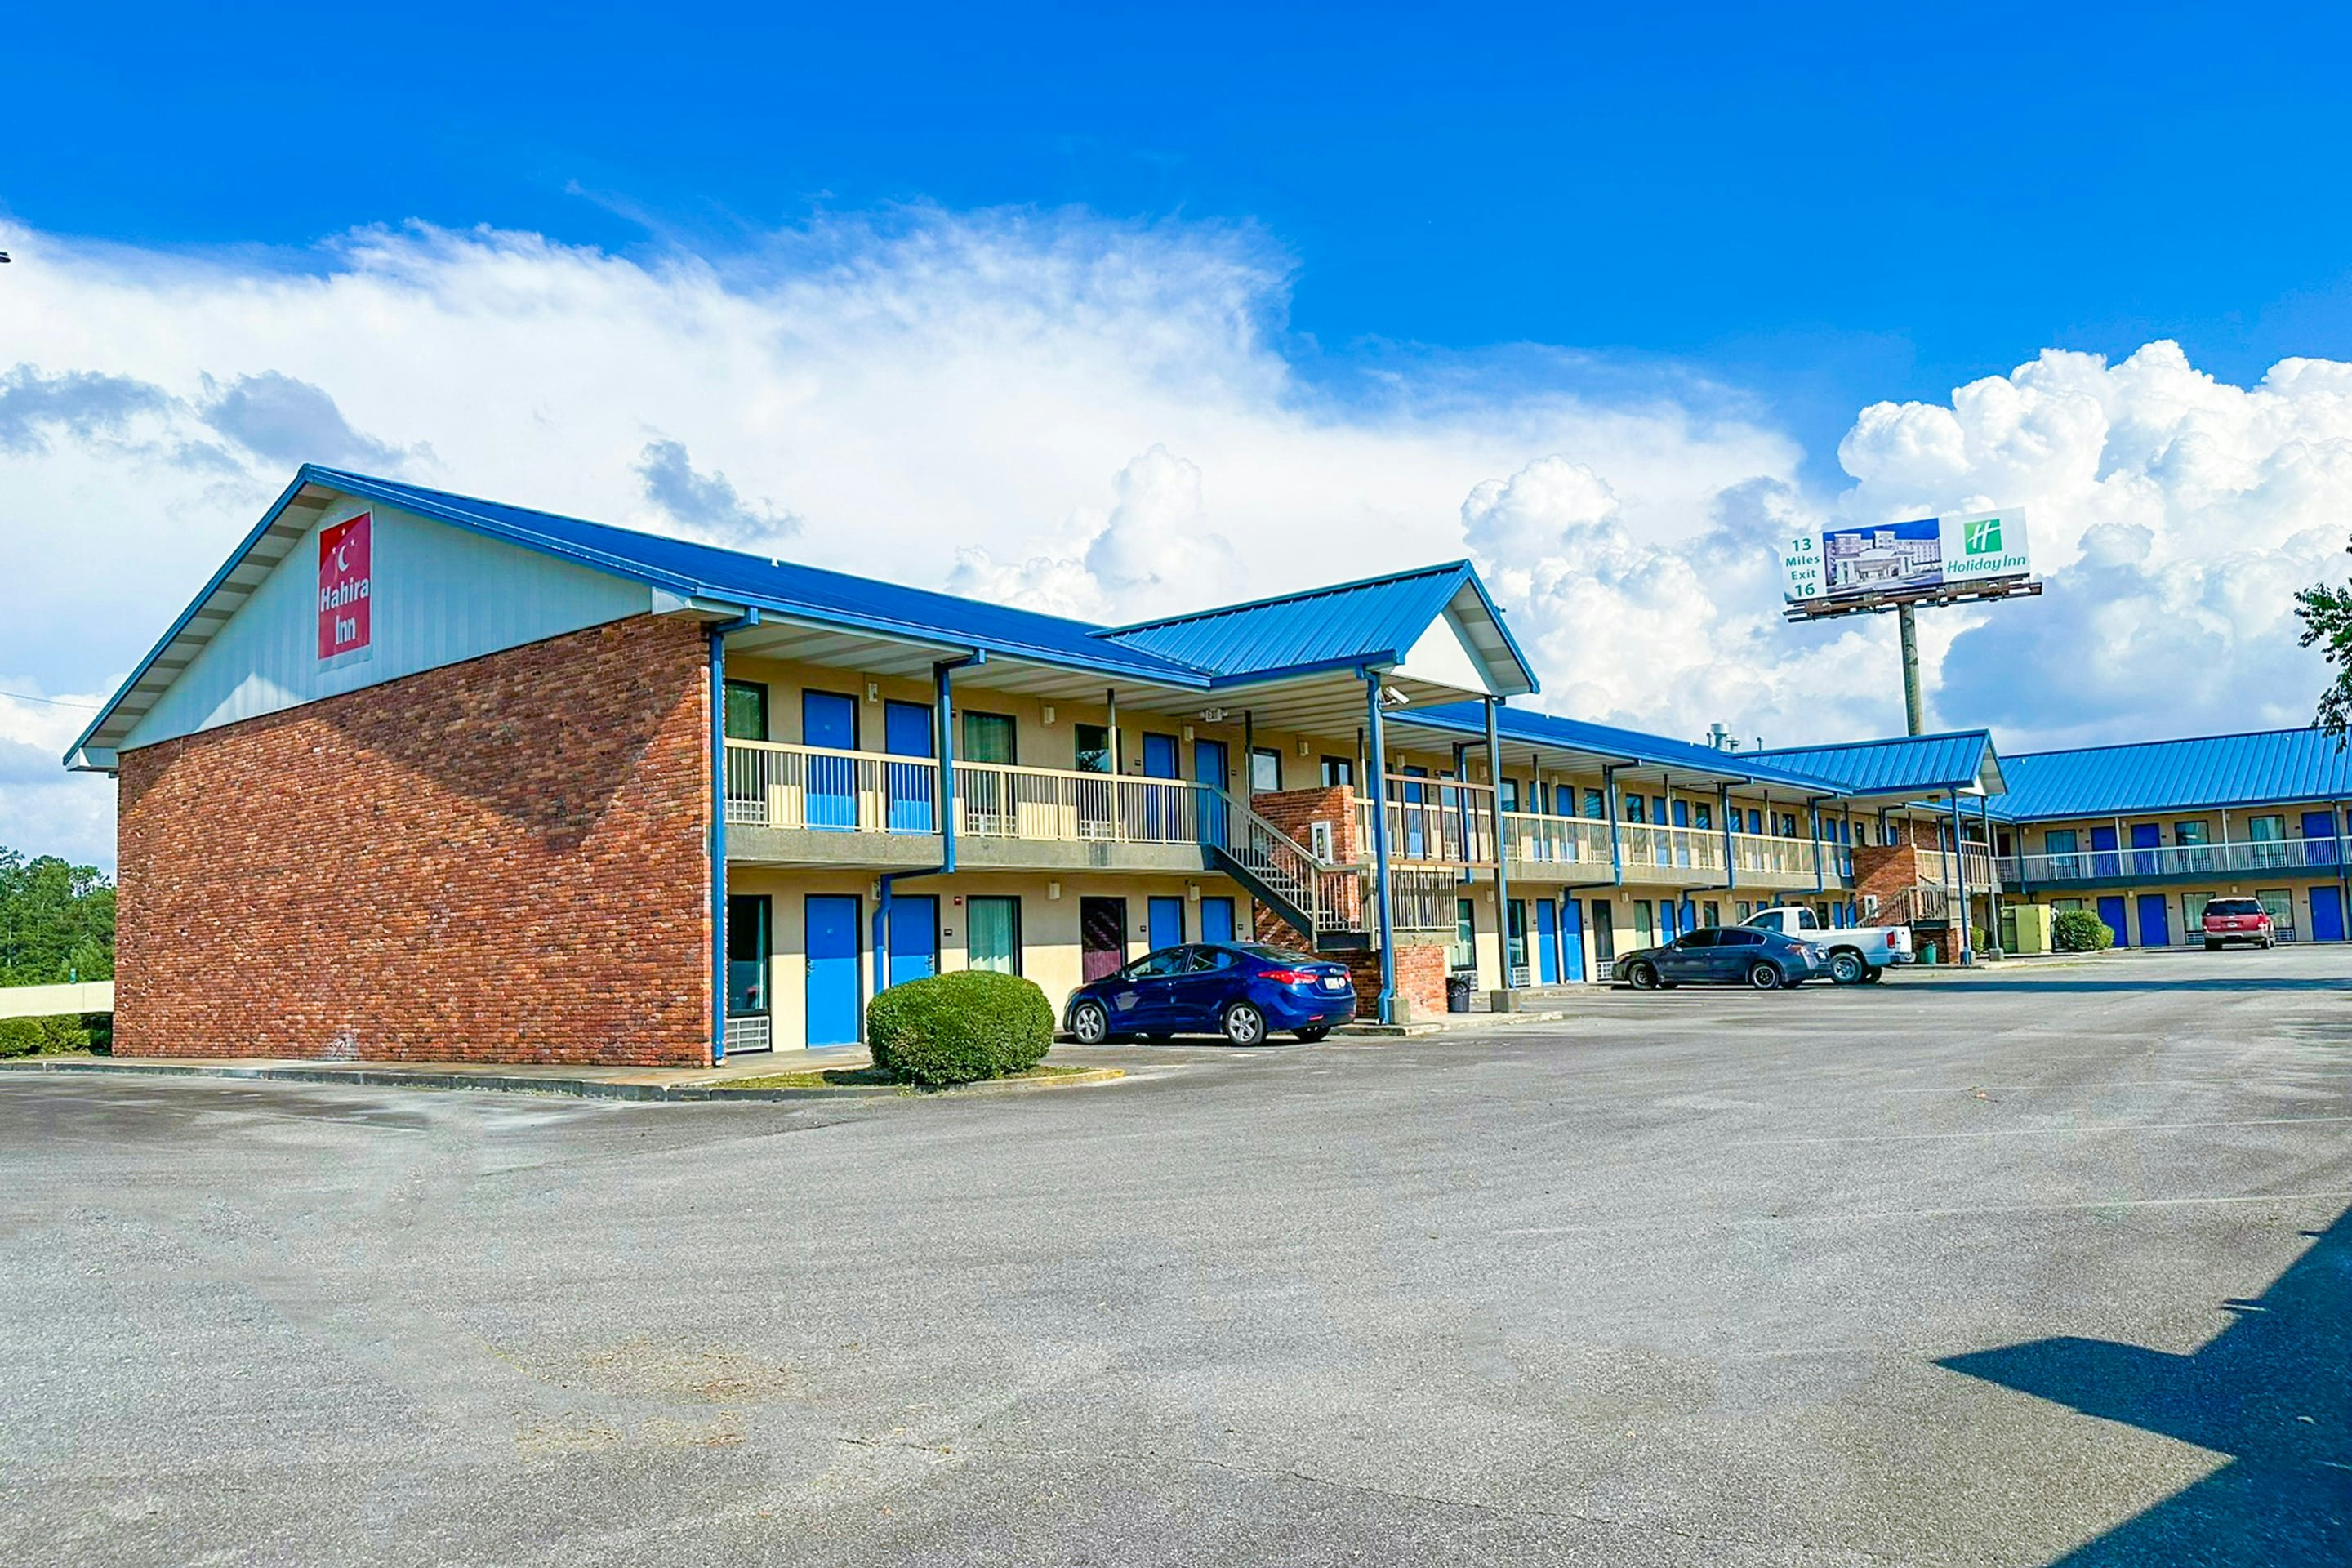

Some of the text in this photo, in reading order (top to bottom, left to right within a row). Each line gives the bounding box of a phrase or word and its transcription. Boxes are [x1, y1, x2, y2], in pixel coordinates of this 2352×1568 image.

[1792, 538, 1811, 551] 13
[1786, 555, 1820, 567] Miles
[1947, 555, 2025, 573] Holiday Inn
[1791, 569, 1815, 580] Exit
[321, 577, 369, 612] Hahira
[1795, 582, 1815, 597] 16
[336, 615, 356, 644] Inn
